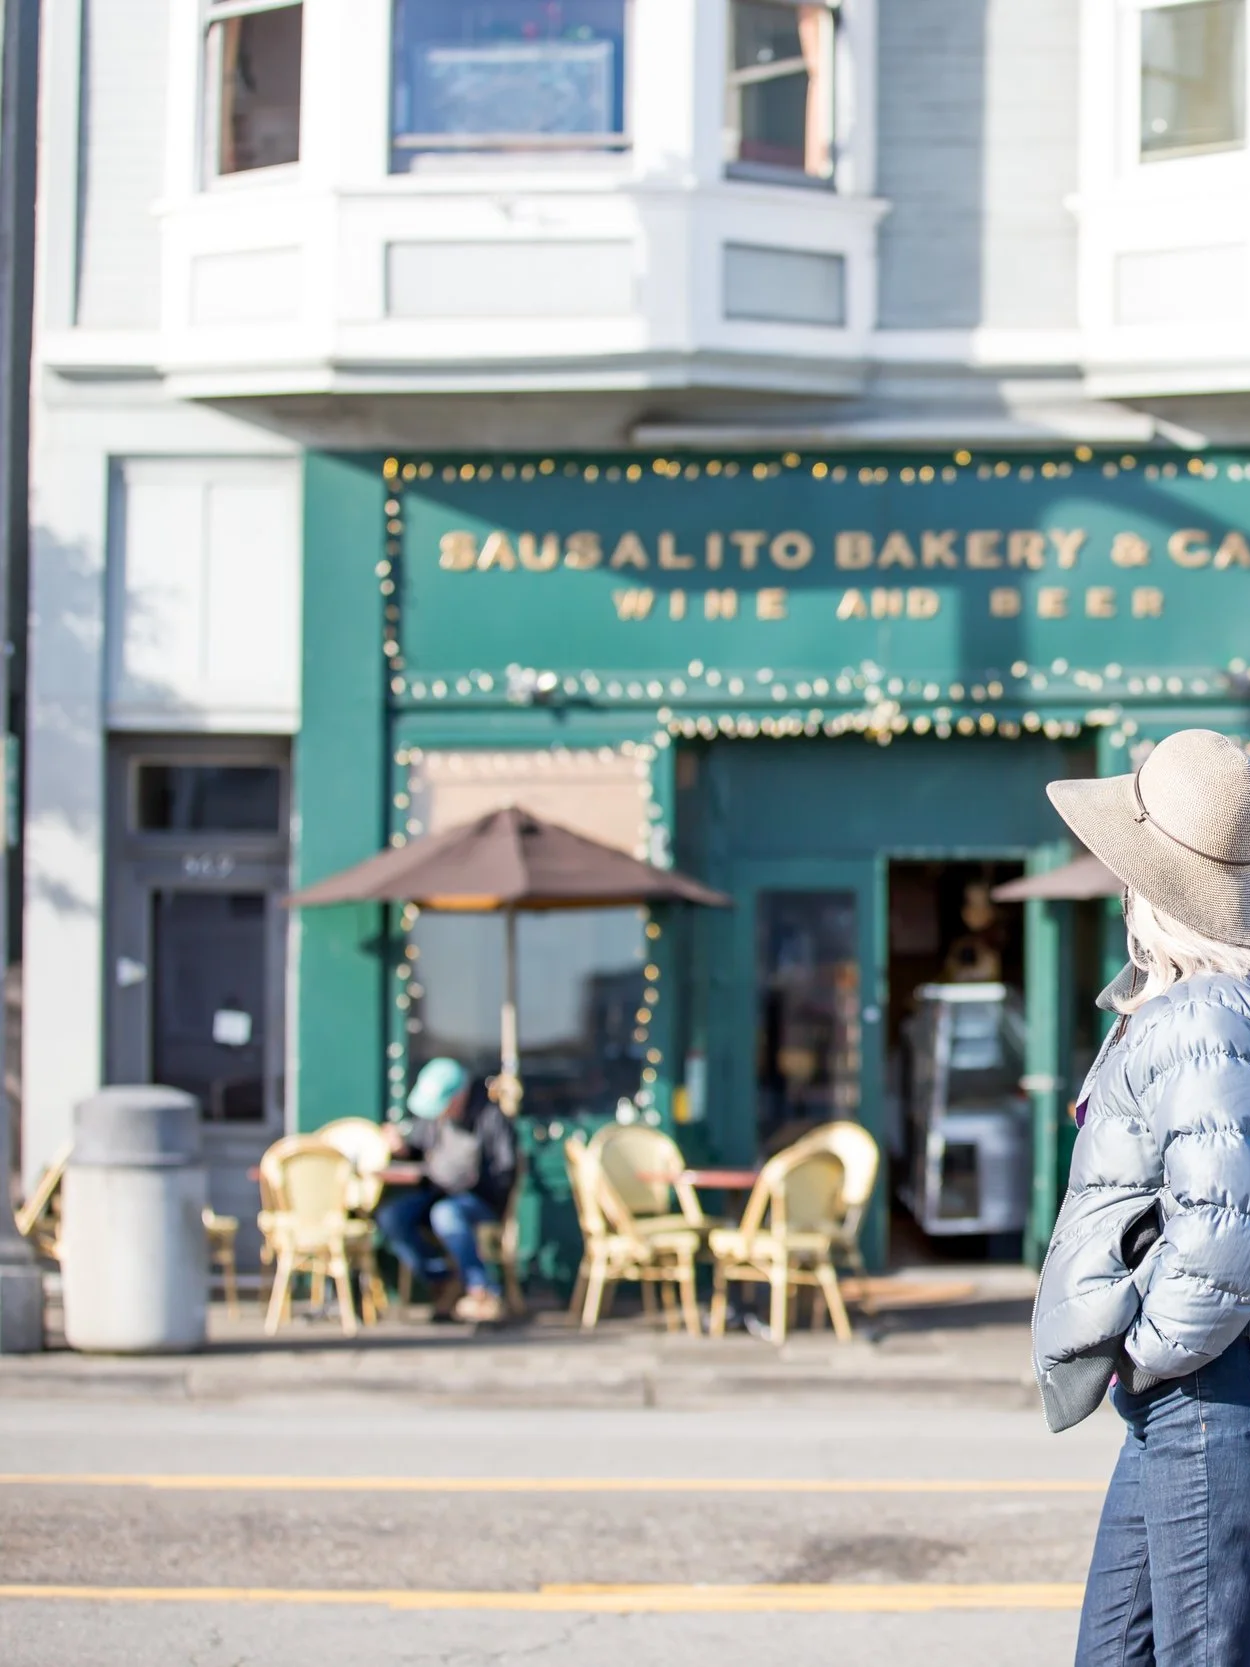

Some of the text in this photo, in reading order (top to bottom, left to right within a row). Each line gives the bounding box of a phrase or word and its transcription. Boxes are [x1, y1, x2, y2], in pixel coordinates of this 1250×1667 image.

[439, 530, 814, 572] SAUSALITO
[834, 529, 1087, 570] BAKERY
[1111, 531, 1150, 568] &
[611, 586, 1164, 621] WINE AND BEER
